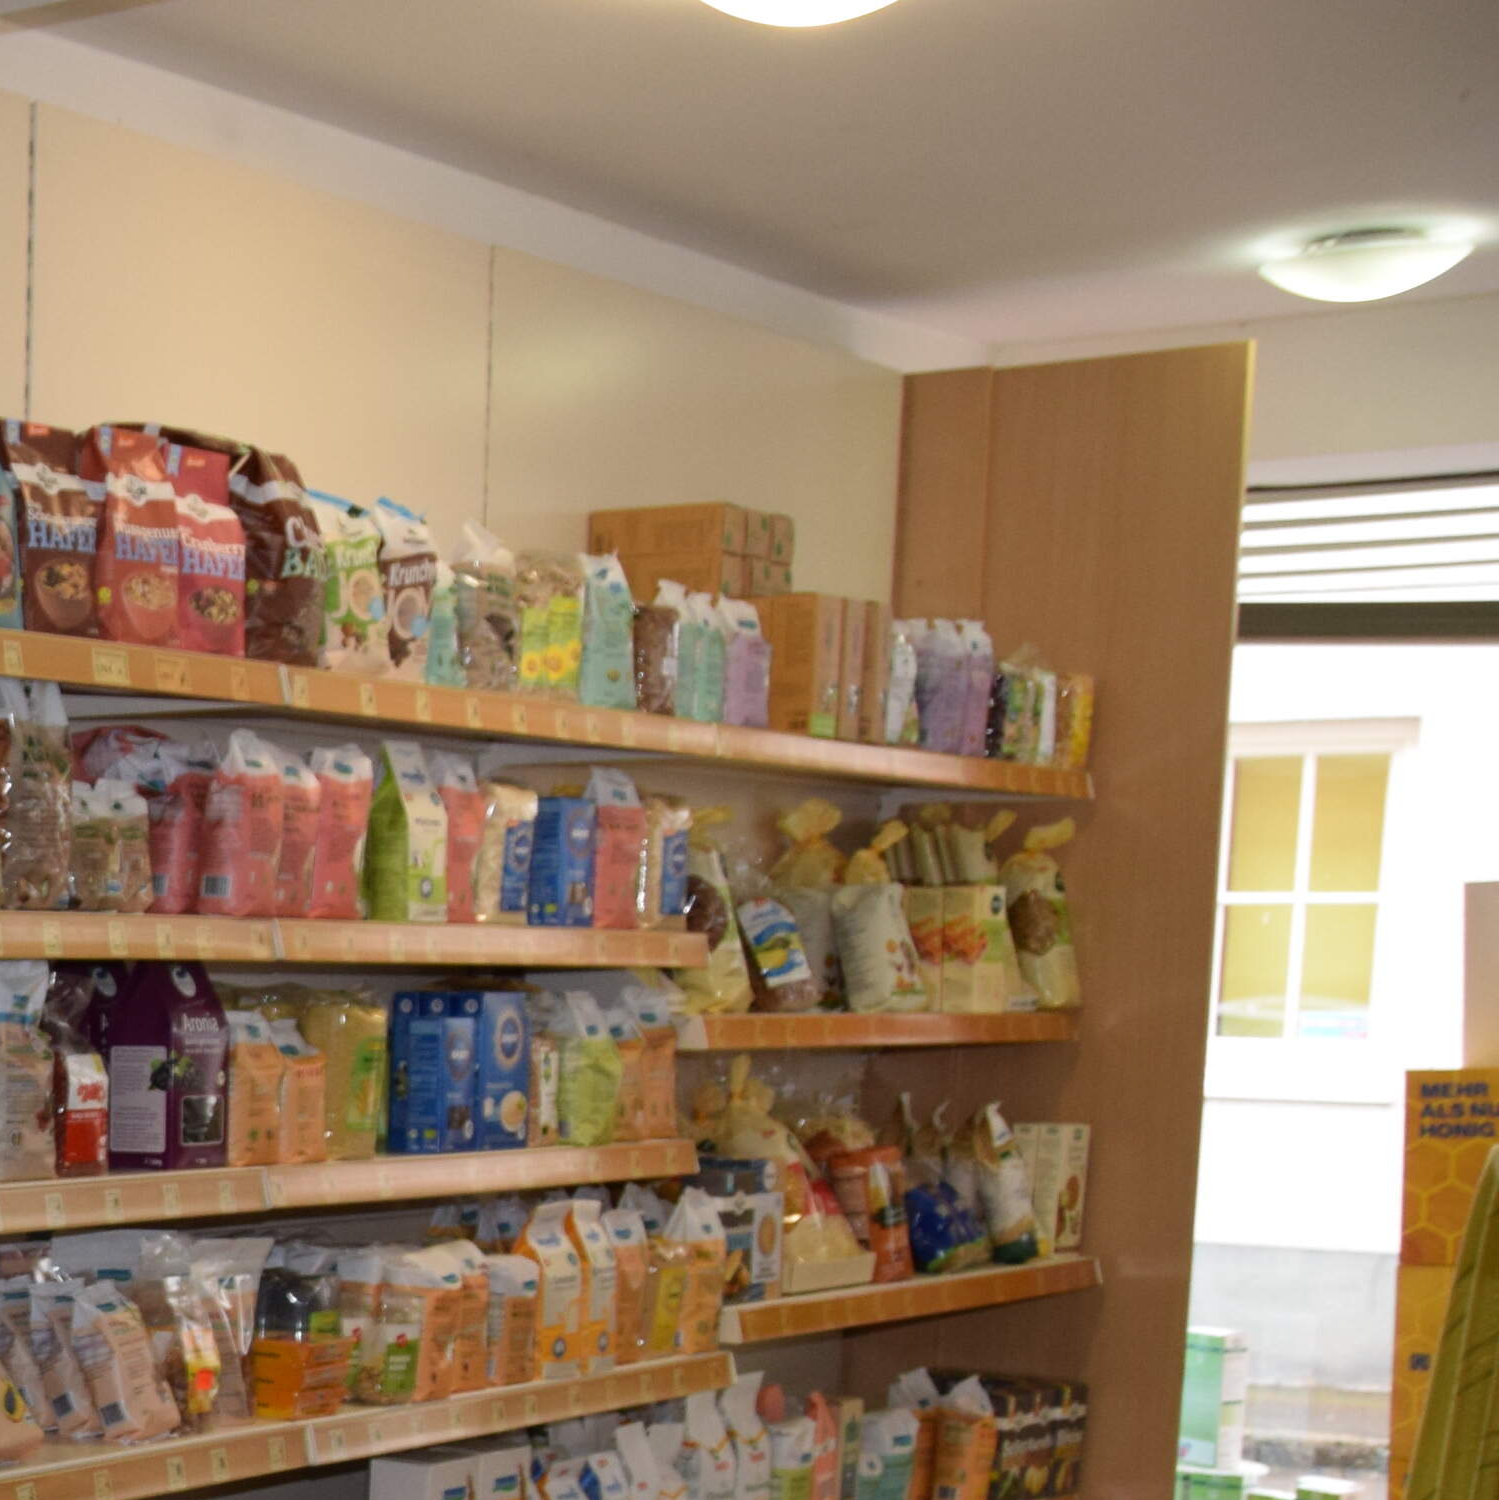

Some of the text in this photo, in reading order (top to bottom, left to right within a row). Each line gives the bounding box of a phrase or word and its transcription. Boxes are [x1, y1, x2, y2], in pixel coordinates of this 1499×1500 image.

[1421, 1083, 1488, 1097] MEHR
[1421, 1104, 1462, 1118] ALS
[1420, 1123, 1495, 1138] HONIG
